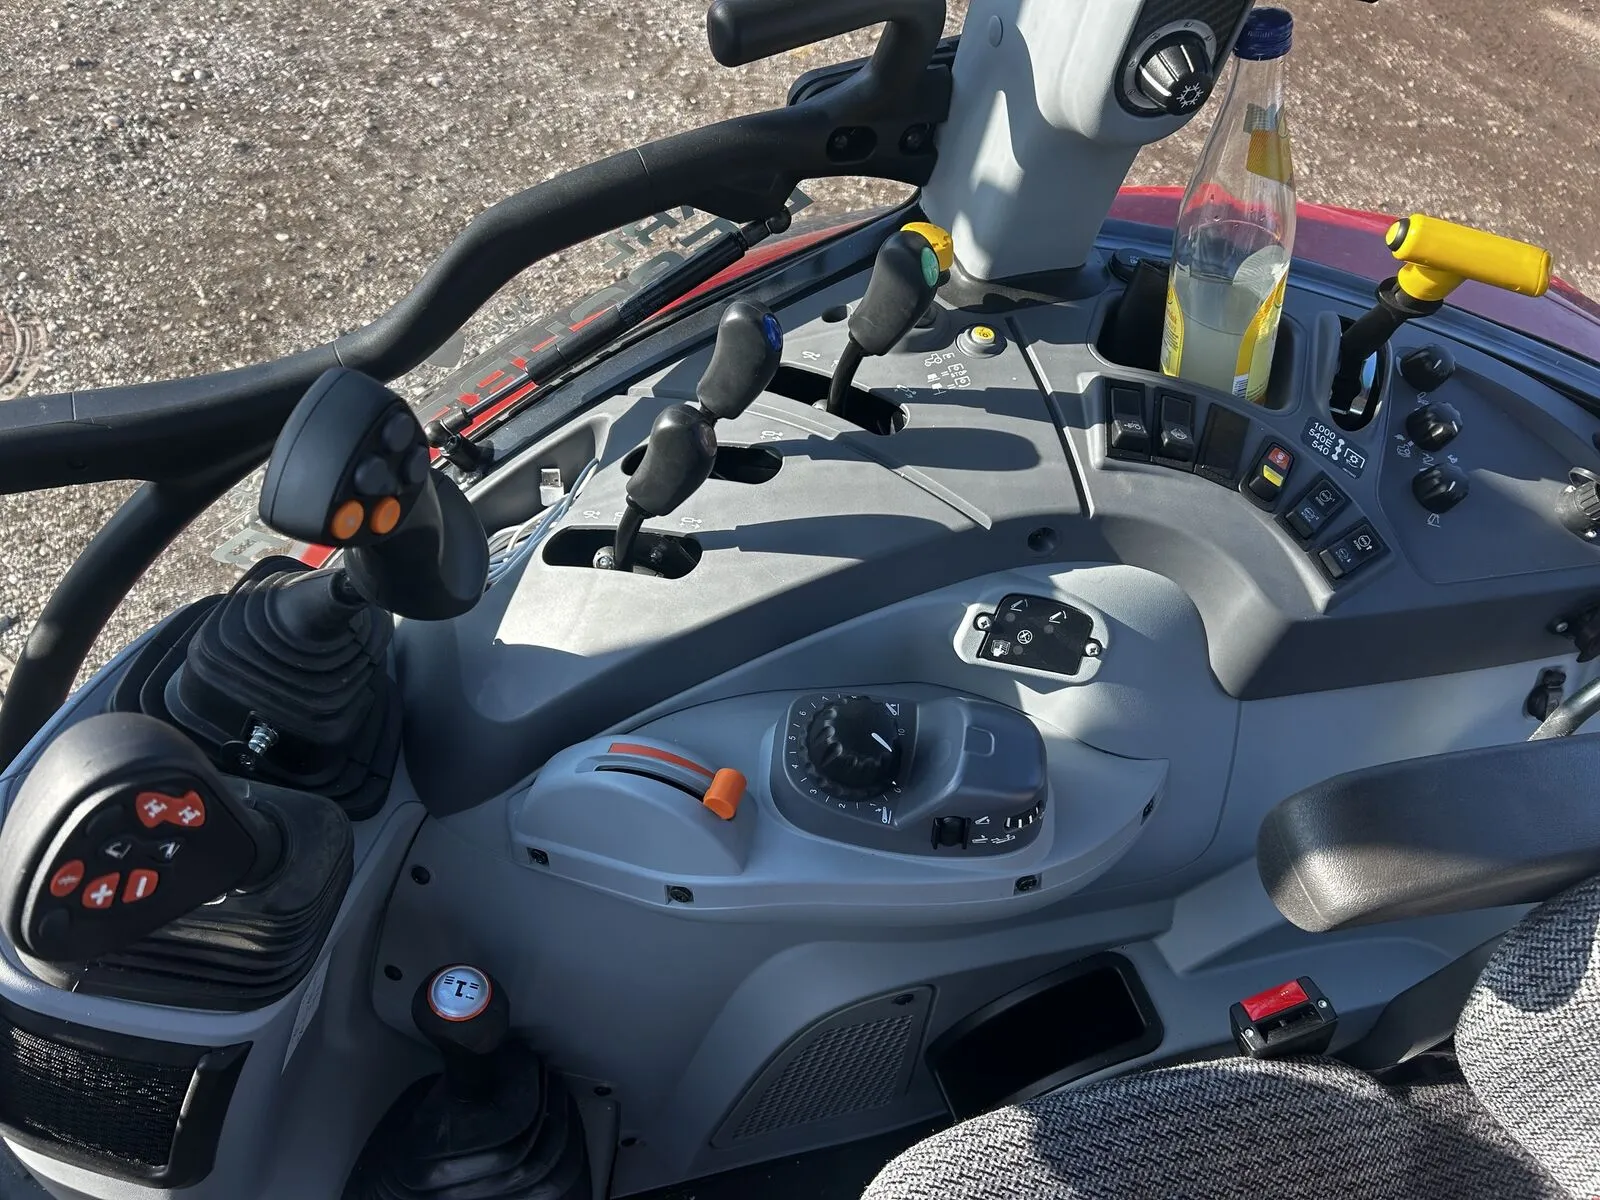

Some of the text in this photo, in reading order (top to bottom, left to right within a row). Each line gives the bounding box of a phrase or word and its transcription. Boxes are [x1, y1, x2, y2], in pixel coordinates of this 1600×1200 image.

[951, 369, 967, 377] STOP
[1308, 428, 1333, 448] 540E
[1314, 422, 1336, 440] 1000
[1311, 440, 1329, 455] 540
[898, 728, 905, 736] 10
